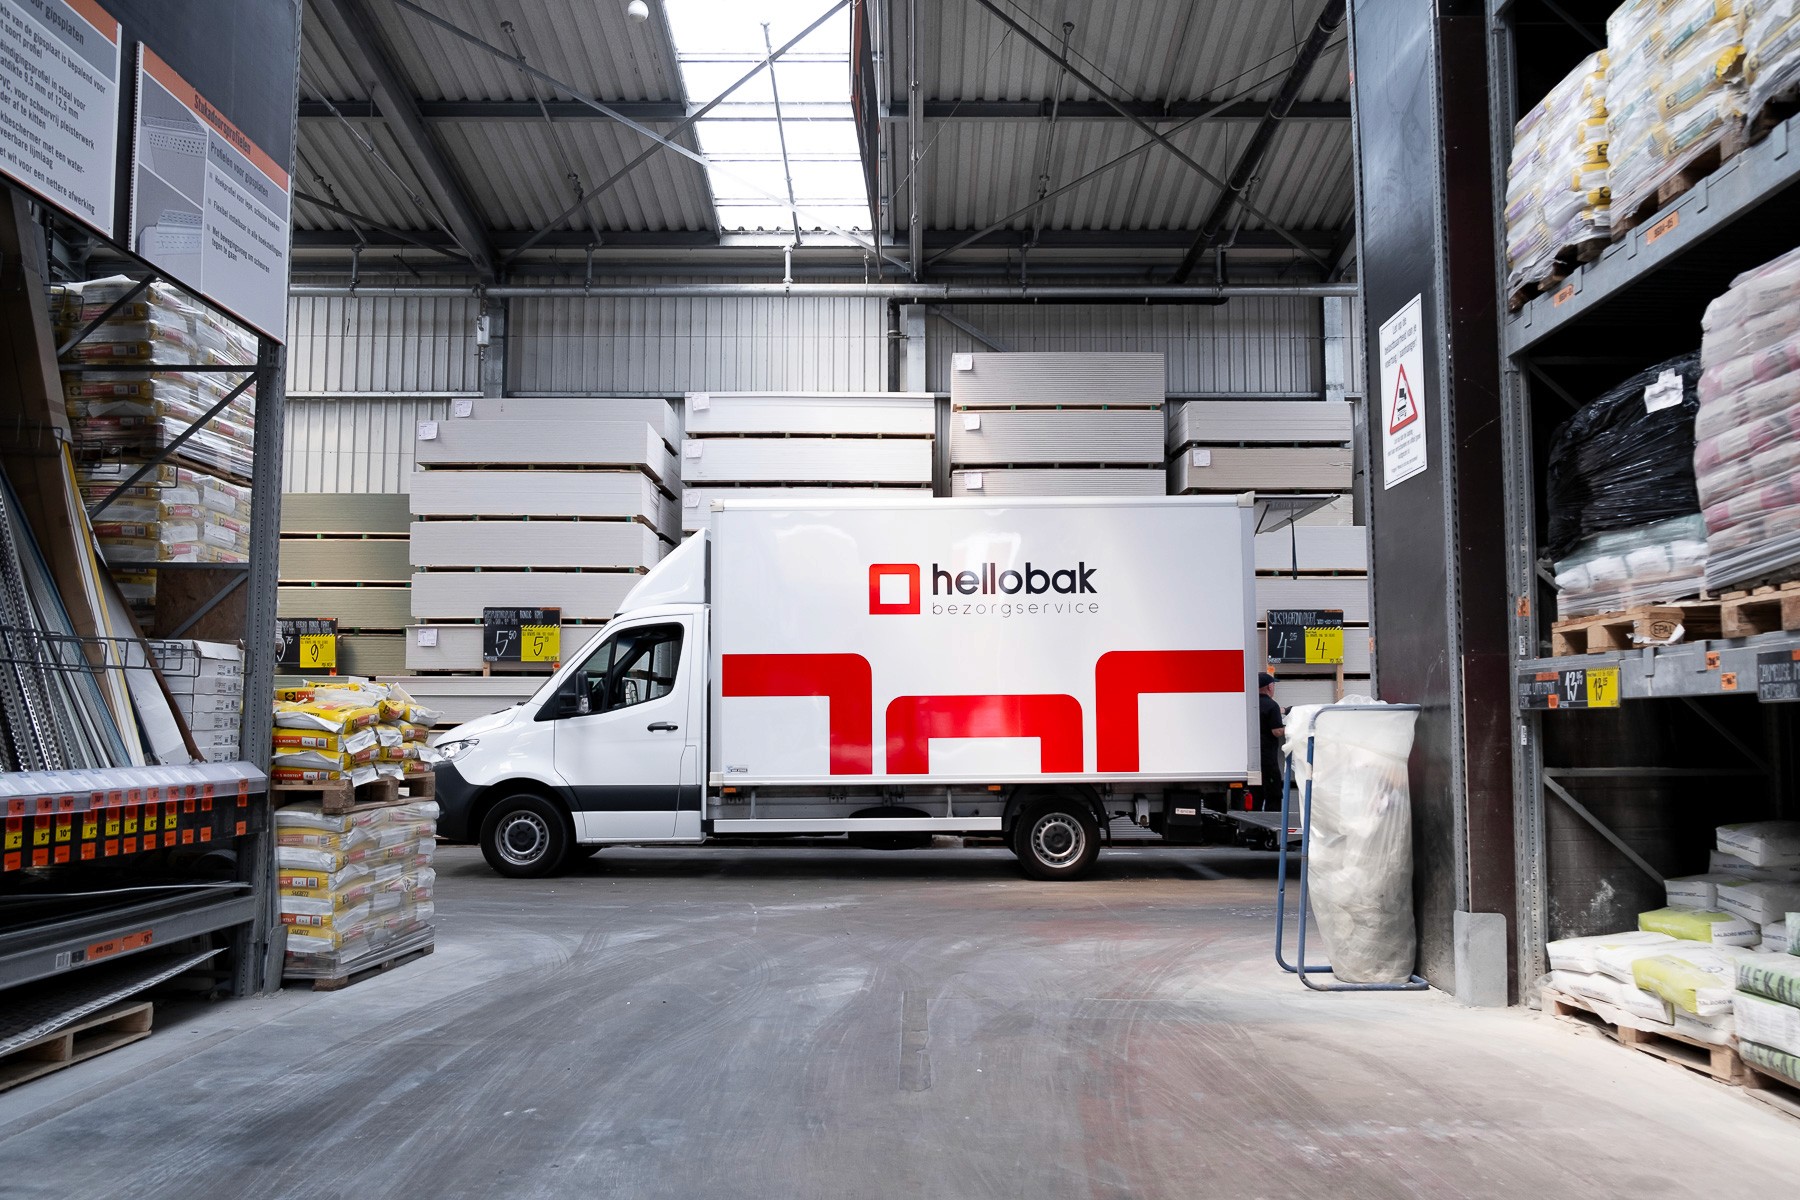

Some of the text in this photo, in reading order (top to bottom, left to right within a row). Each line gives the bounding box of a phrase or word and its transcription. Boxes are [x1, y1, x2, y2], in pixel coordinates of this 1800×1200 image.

[5, 24, 22, 43] soort
[23, 38, 42, 59] profiel
[45, 5, 84, 45] gipsplaten
[12, 14, 24, 29] van
[24, 23, 32, 37] de
[33, 32, 61, 60] gipsplaat
[62, 52, 66, 64] is
[67, 57, 93, 85] bepalend
[93, 79, 106, 94] voor
[24, 72, 34, 87] 9,5
[35, 82, 47, 96] mm
[47, 91, 54, 102] of
[55, 95, 67, 112] 12,5
[68, 106, 79, 120] mm
[51, 77, 57, 90] in
[58, 85, 73, 101] staal
[73, 96, 86, 111] voor
[12, 99, 20, 111] af
[20, 104, 27, 117] te
[28, 109, 46, 130] kitten
[14, 86, 28, 102] voor
[29, 98, 60, 127] scheurvrij
[60, 119, 95, 150] pleisterwerk
[194, 93, 251, 155] Stukadoorsprofielen
[29, 145, 53, 170] lijmlaag
[43, 141, 54, 155] met
[55, 149, 66, 162] een
[67, 157, 85, 174] water-
[210, 141, 269, 198] Profielen voor gipsplaten
[7, 151, 17, 165] wit
[19, 158, 32, 174] voor
[33, 169, 45, 182] een
[46, 176, 67, 196] nettere
[68, 190, 96, 216] afwerking
[932, 561, 1098, 595] hellobak
[932, 602, 1099, 619] bezorgservice
[310, 643, 319, 663] 9
[533, 636, 544, 657] 5
[1315, 638, 1328, 659] 4
